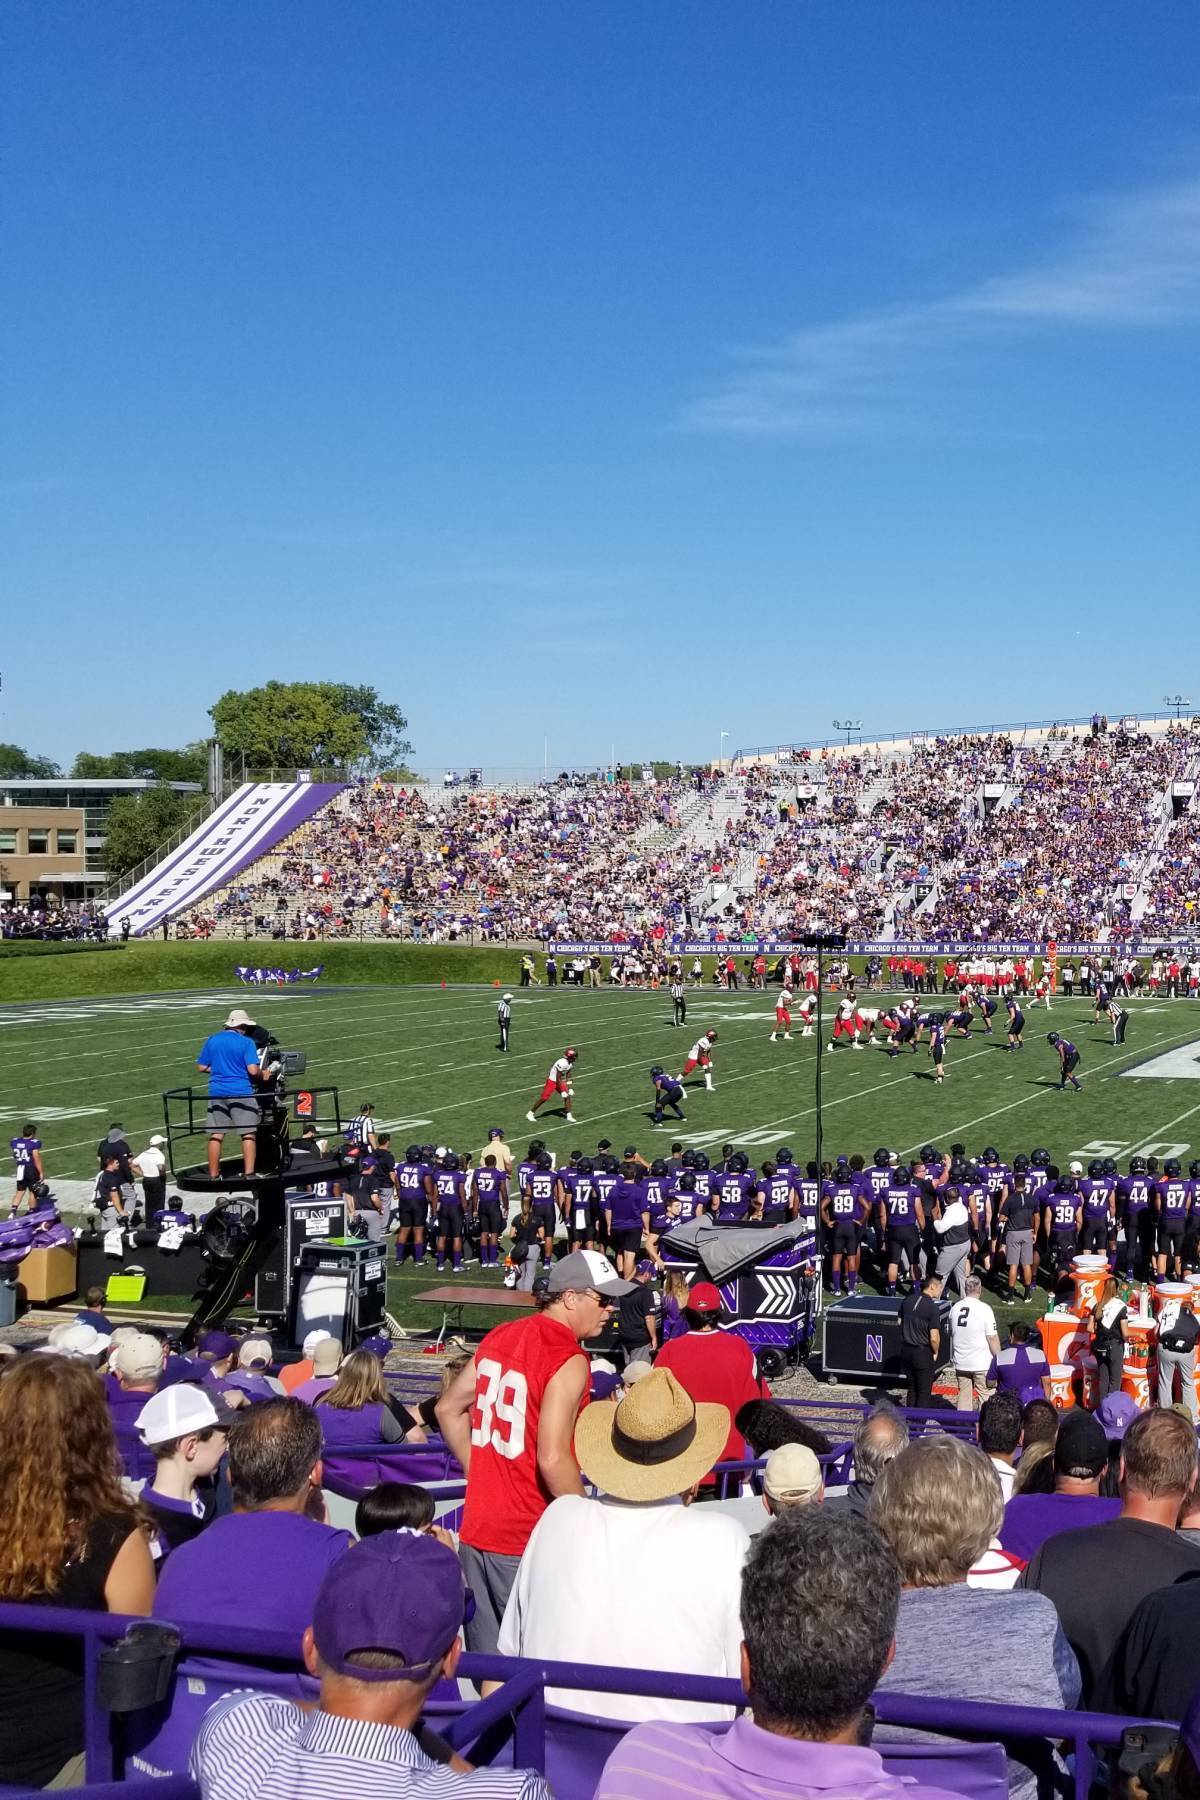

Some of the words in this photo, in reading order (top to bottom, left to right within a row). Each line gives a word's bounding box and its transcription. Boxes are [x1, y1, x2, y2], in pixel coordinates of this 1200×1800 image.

[131, 796, 271, 916] NORTHWESTERN
[944, 945, 949, 953] N
[1035, 945, 1040, 953] N
[1046, 945, 1077, 953] CCAGO'S
[1103, 945, 1120, 953] TEM
[297, 1091, 313, 1114] 2
[670, 1129, 795, 1146] 40
[1068, 1140, 1191, 1160] 50
[400, 1173, 419, 1189] 94
[477, 1178, 494, 1192] 27
[533, 1182, 551, 1198] 23
[575, 1185, 592, 1202] 17
[647, 1188, 663, 1204] 41
[721, 1186, 741, 1203] 58
[771, 1186, 789, 1205] 92
[1089, 1189, 1108, 1206] 47
[1130, 1187, 1148, 1203] 44
[834, 1195, 853, 1213] 89
[888, 1197, 909, 1214] 78
[1166, 1190, 1186, 1208] 87
[1055, 1205, 1074, 1222] 39
[1081, 1282, 1094, 1299] G
[957, 1306, 970, 1327] 2
[866, 1334, 883, 1362] N
[471, 1357, 528, 1460] 39
